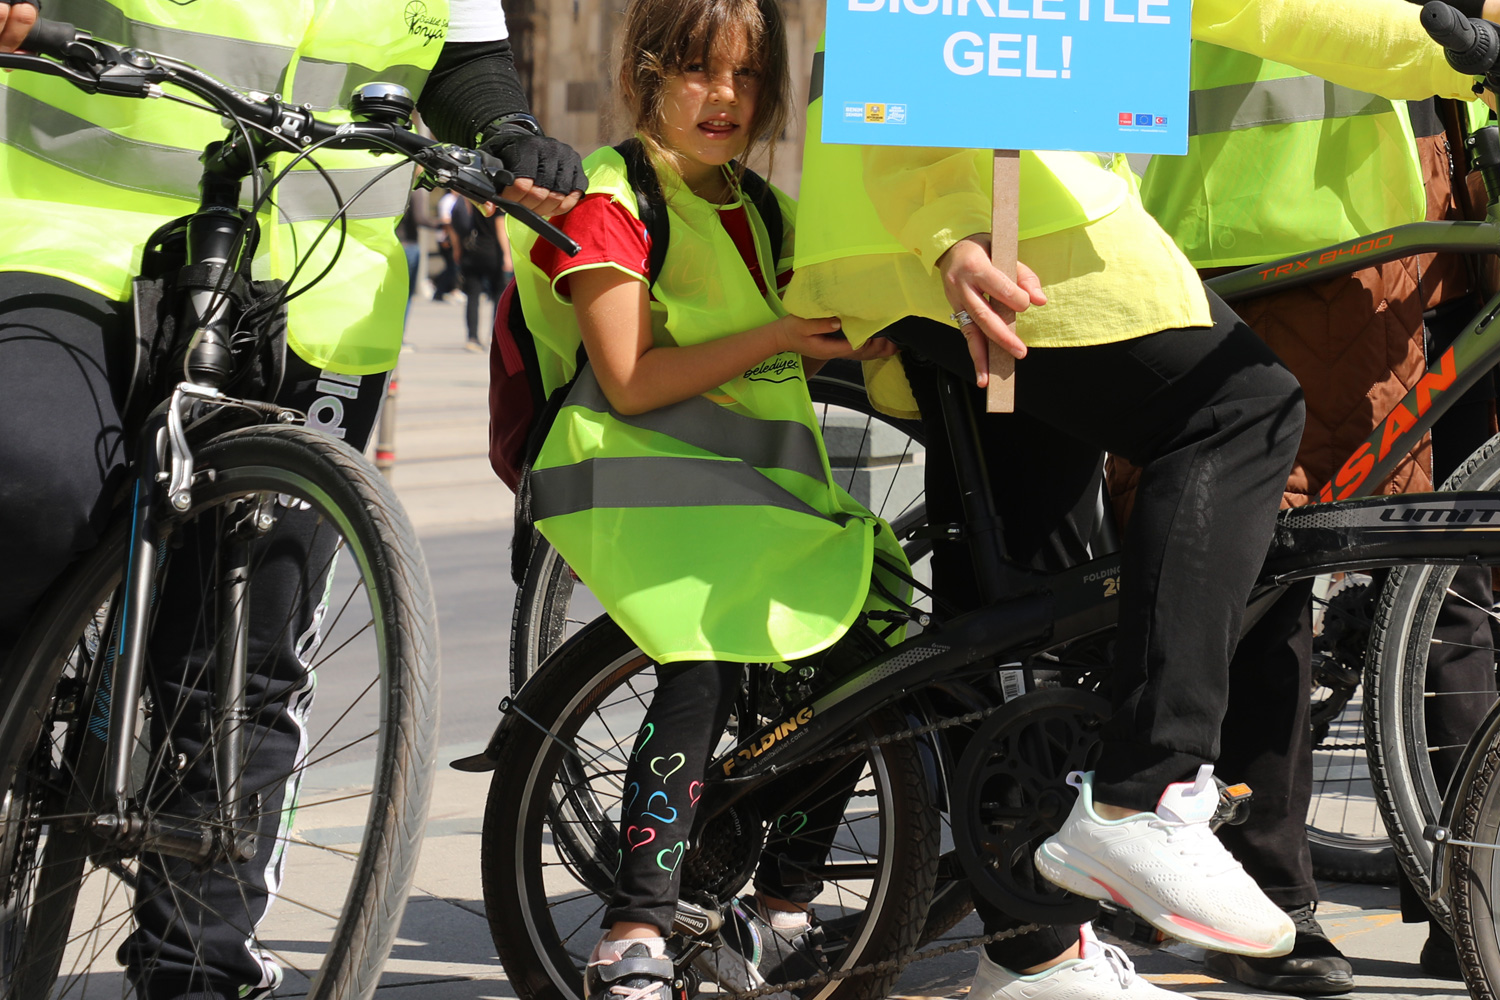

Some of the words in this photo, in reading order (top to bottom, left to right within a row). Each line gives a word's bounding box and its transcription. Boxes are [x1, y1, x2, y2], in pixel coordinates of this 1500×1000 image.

[943, 30, 1073, 79] GEL!
[1258, 257, 1312, 281] TRX
[1318, 234, 1394, 266] 8400
[722, 706, 814, 777] FOLDING
